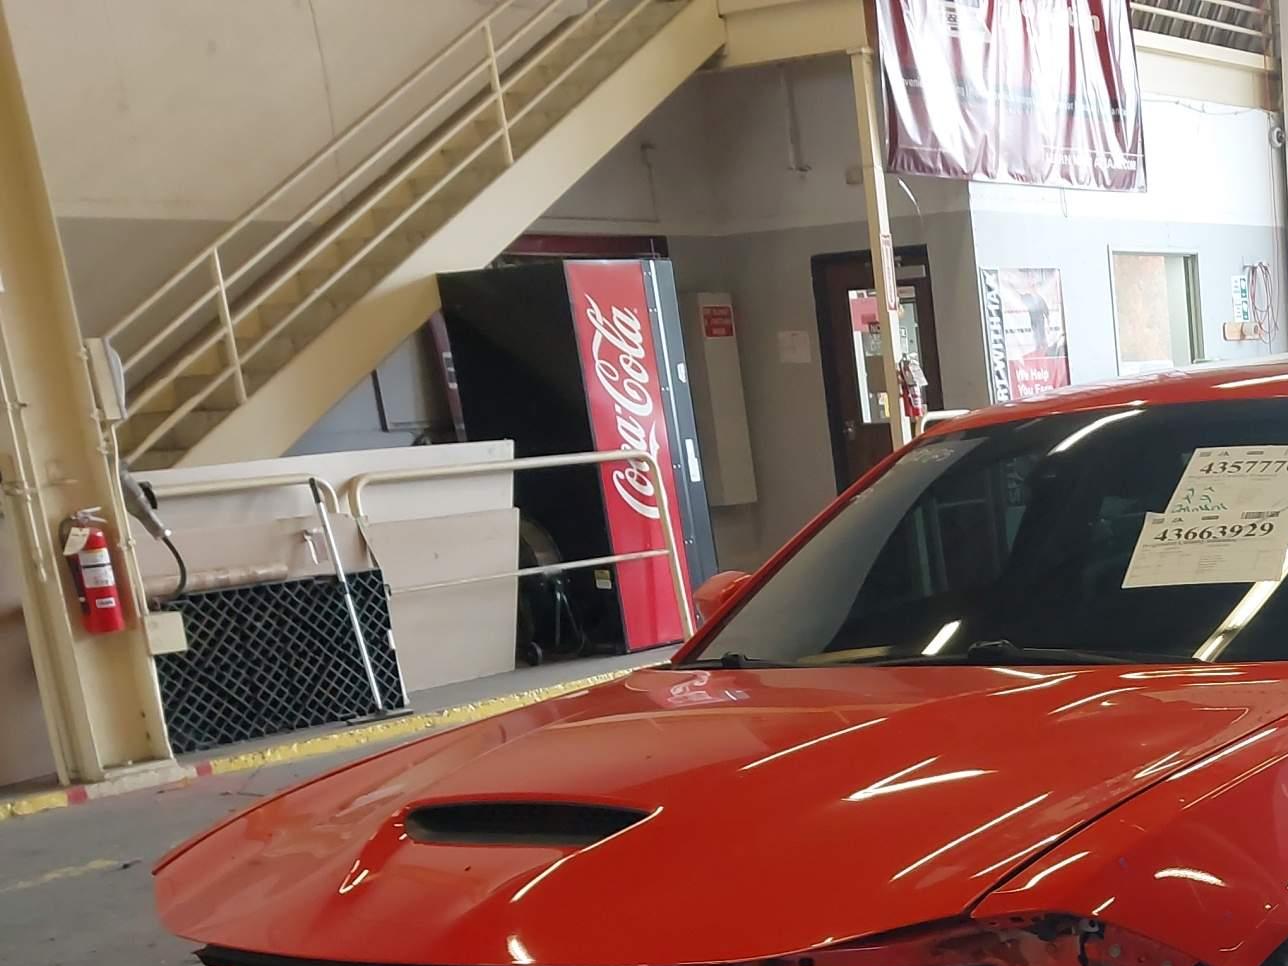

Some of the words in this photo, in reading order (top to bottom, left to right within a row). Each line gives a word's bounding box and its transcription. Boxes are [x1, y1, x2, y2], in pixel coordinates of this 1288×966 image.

[1015, 369, 1029, 381] We
[1030, 368, 1050, 382] Help
[1017, 384, 1034, 396] You
[1153, 522, 1275, 541] 43663929
